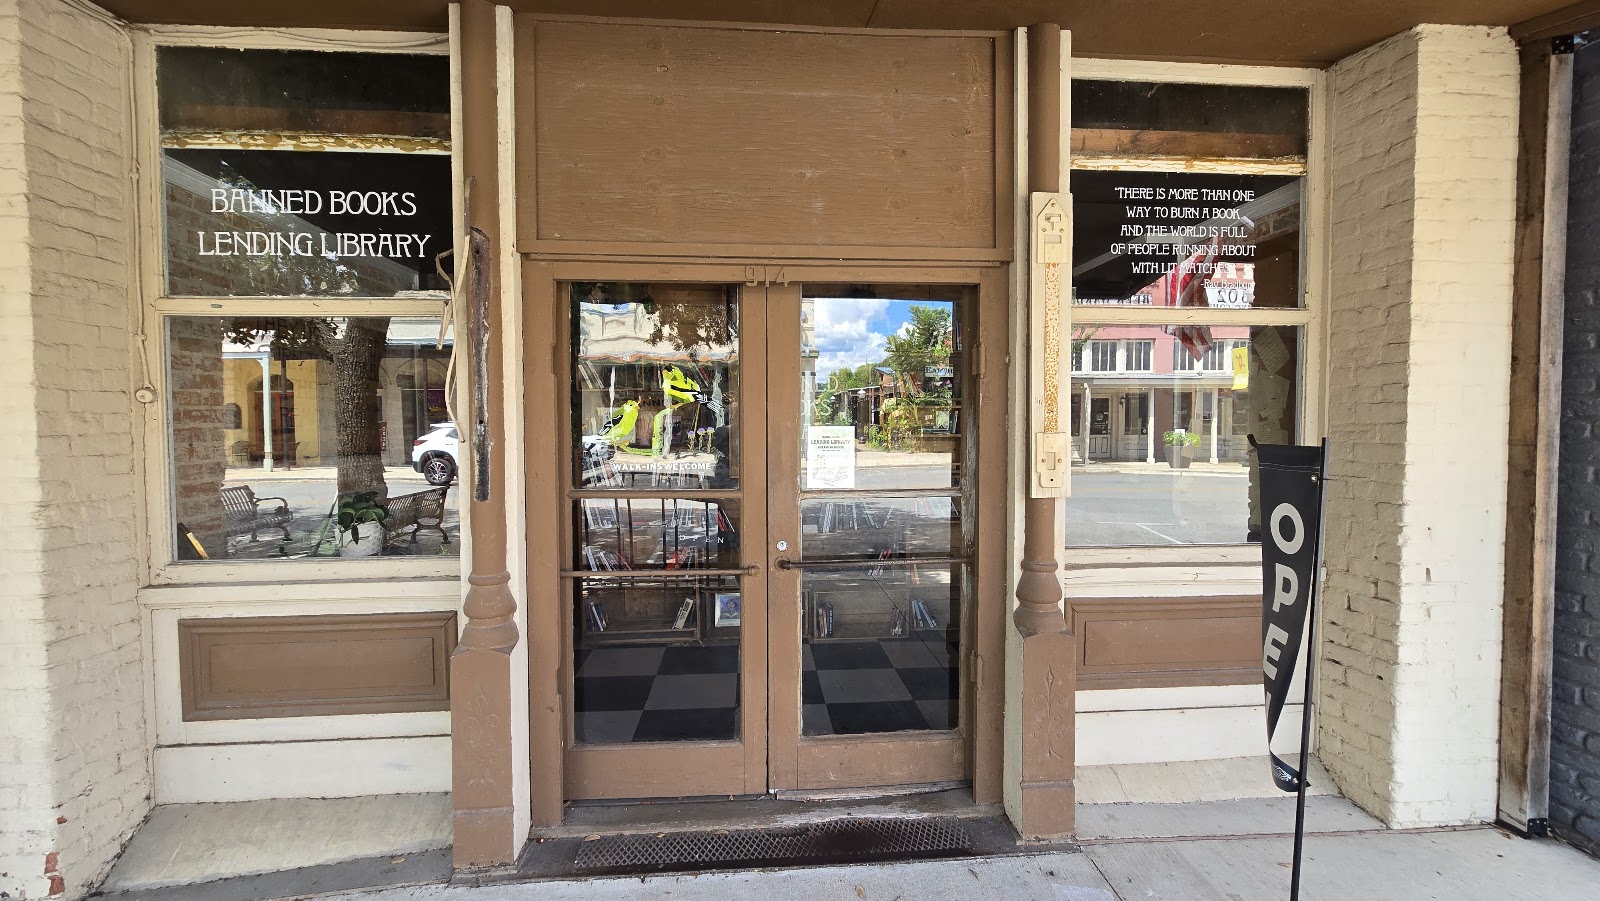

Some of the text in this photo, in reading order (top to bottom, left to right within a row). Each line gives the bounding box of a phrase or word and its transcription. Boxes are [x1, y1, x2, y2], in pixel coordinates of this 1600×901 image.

[1156, 187, 1166, 200] IS
[1168, 188, 1199, 201] MORE
[1201, 189, 1231, 202] THAN
[1232, 190, 1255, 202] ONE
[210, 188, 417, 216] BANNED BOOKS
[1126, 206, 1152, 218] WAY
[1154, 206, 1169, 218] TO
[1170, 206, 1200, 219] BURN
[1201, 207, 1210, 219] A
[1120, 225, 1248, 238] AND THE WORLD IS FULL
[197, 230, 431, 258] LENDING LIBRARY
[1110, 243, 1257, 257] OF PEOPLE RUNNING ABOUT
[1131, 262, 1159, 274] WITH
[1160, 262, 1178, 274] LIT
[744, 265, 790, 288] 914
[613, 462, 712, 471] WALK-INS WELCOME
[1262, 502, 1305, 720] OPE
